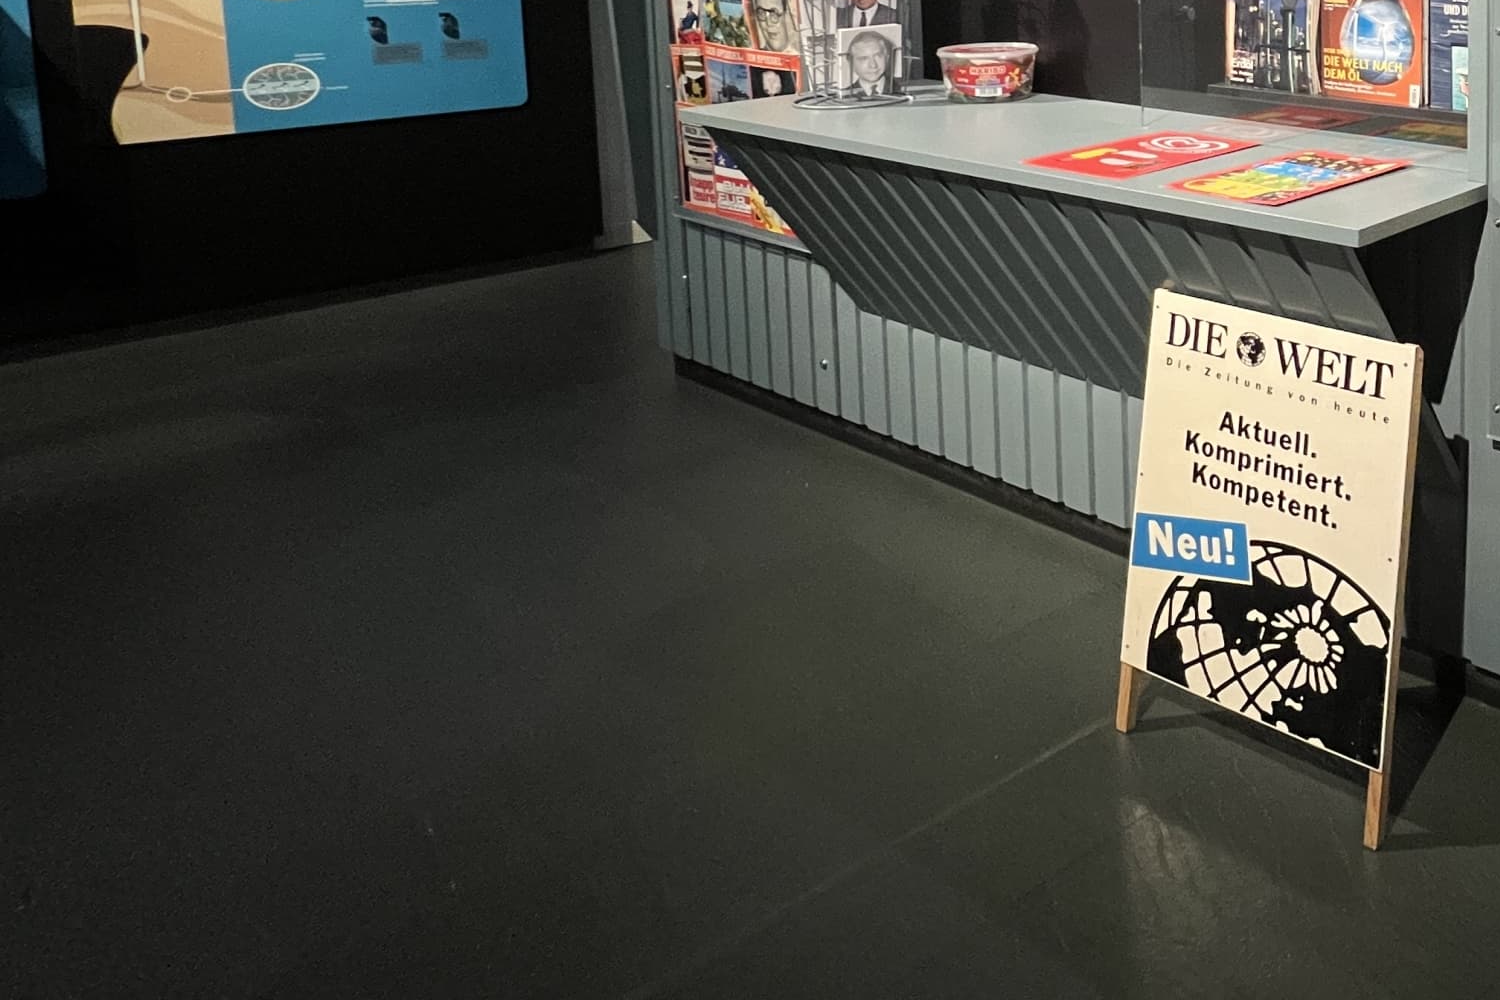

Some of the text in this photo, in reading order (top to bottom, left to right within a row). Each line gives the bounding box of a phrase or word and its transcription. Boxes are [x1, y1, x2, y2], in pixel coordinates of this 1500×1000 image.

[1324, 56, 1403, 73] DIE WELT NACH
[1324, 68, 1361, 82] DEM ÖL
[1166, 312, 1394, 400] DIE WELT
[1166, 356, 1390, 424] Die Zeitung von heute
[1219, 411, 1318, 458] Aktuell.
[1185, 430, 1352, 502] Komprimiert.
[1192, 462, 1338, 530] Kompetent.
[1148, 518, 1236, 566] Neu!
